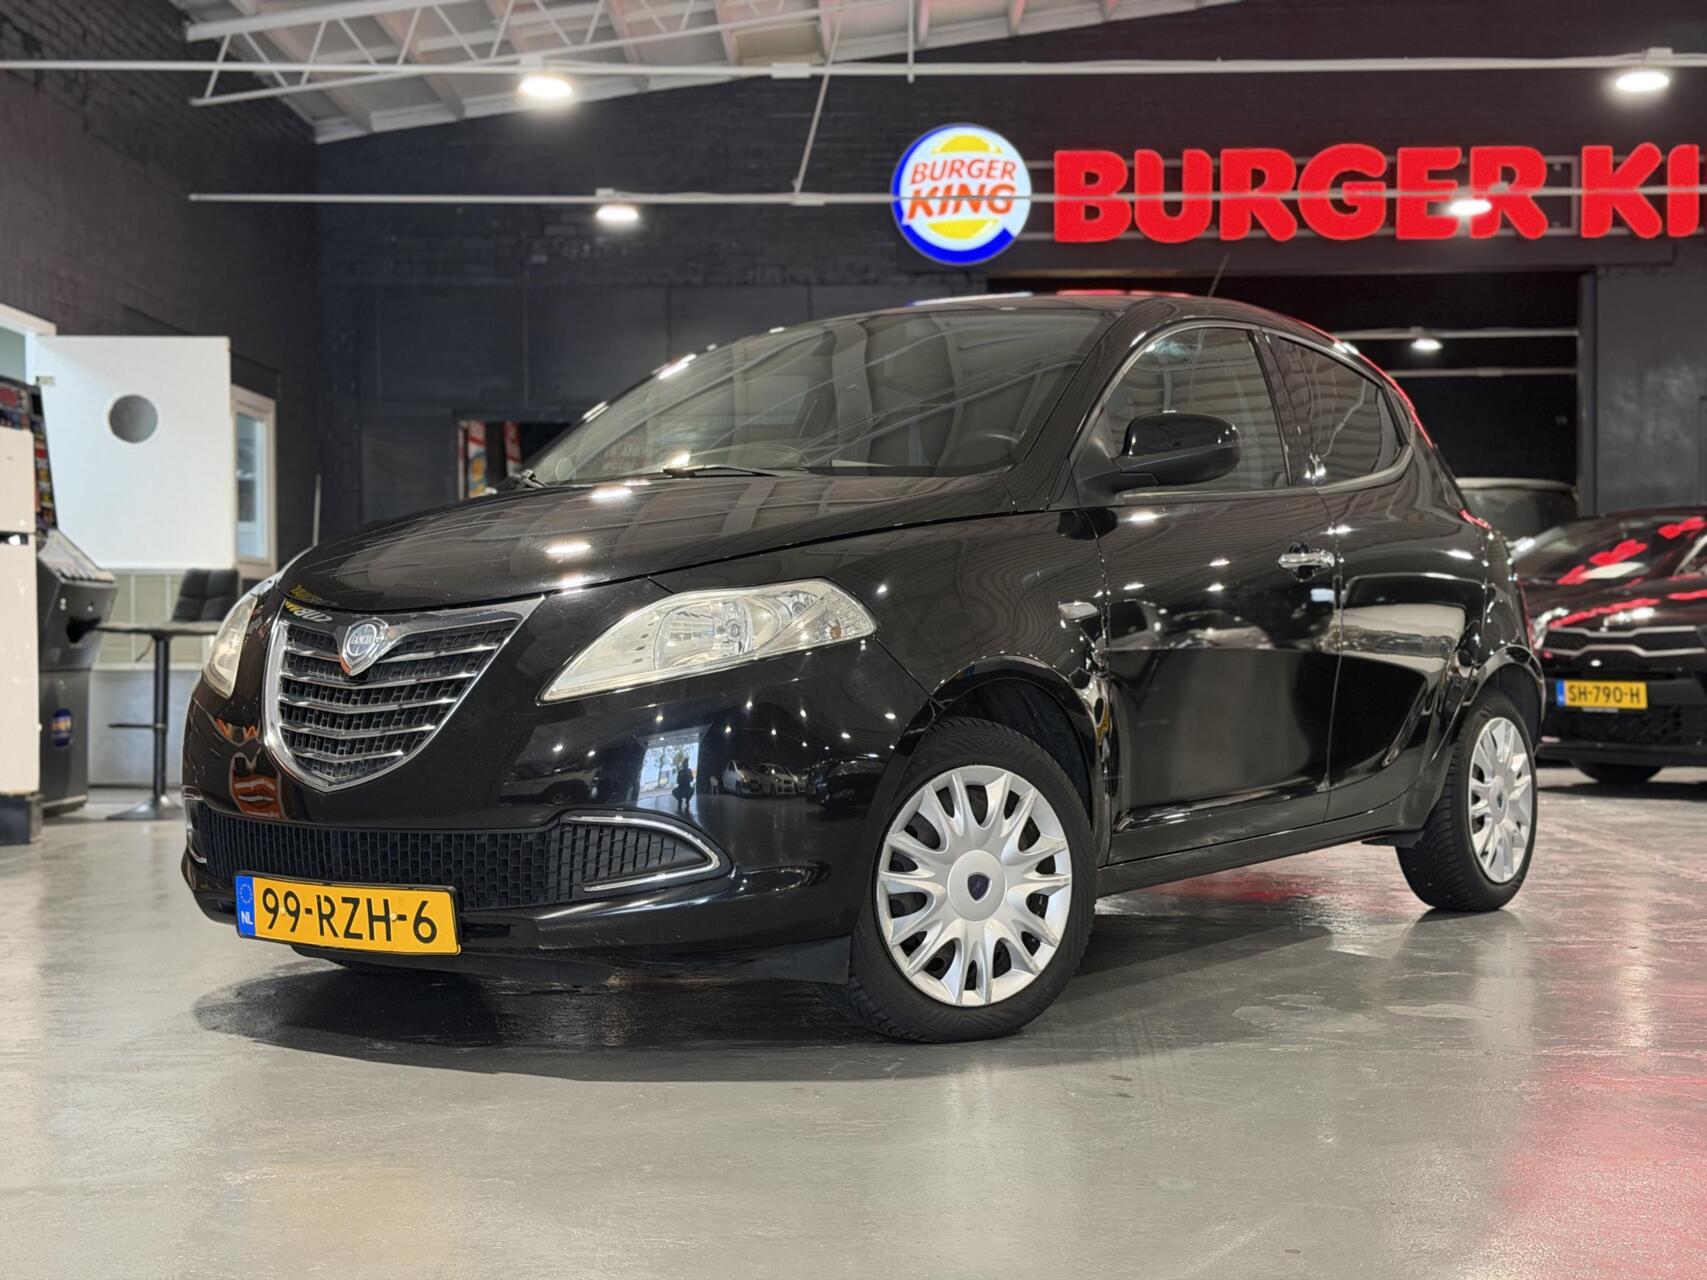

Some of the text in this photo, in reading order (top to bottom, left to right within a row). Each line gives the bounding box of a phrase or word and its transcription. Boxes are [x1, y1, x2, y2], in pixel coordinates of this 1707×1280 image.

[911, 158, 1017, 186] BURGER
[907, 183, 1017, 220] KING
[1053, 142, 1700, 242] BURGER KI
[1567, 684, 1641, 704] SH-790-H
[240, 911, 254, 926] NL
[261, 887, 438, 944] 99-RZH-6
